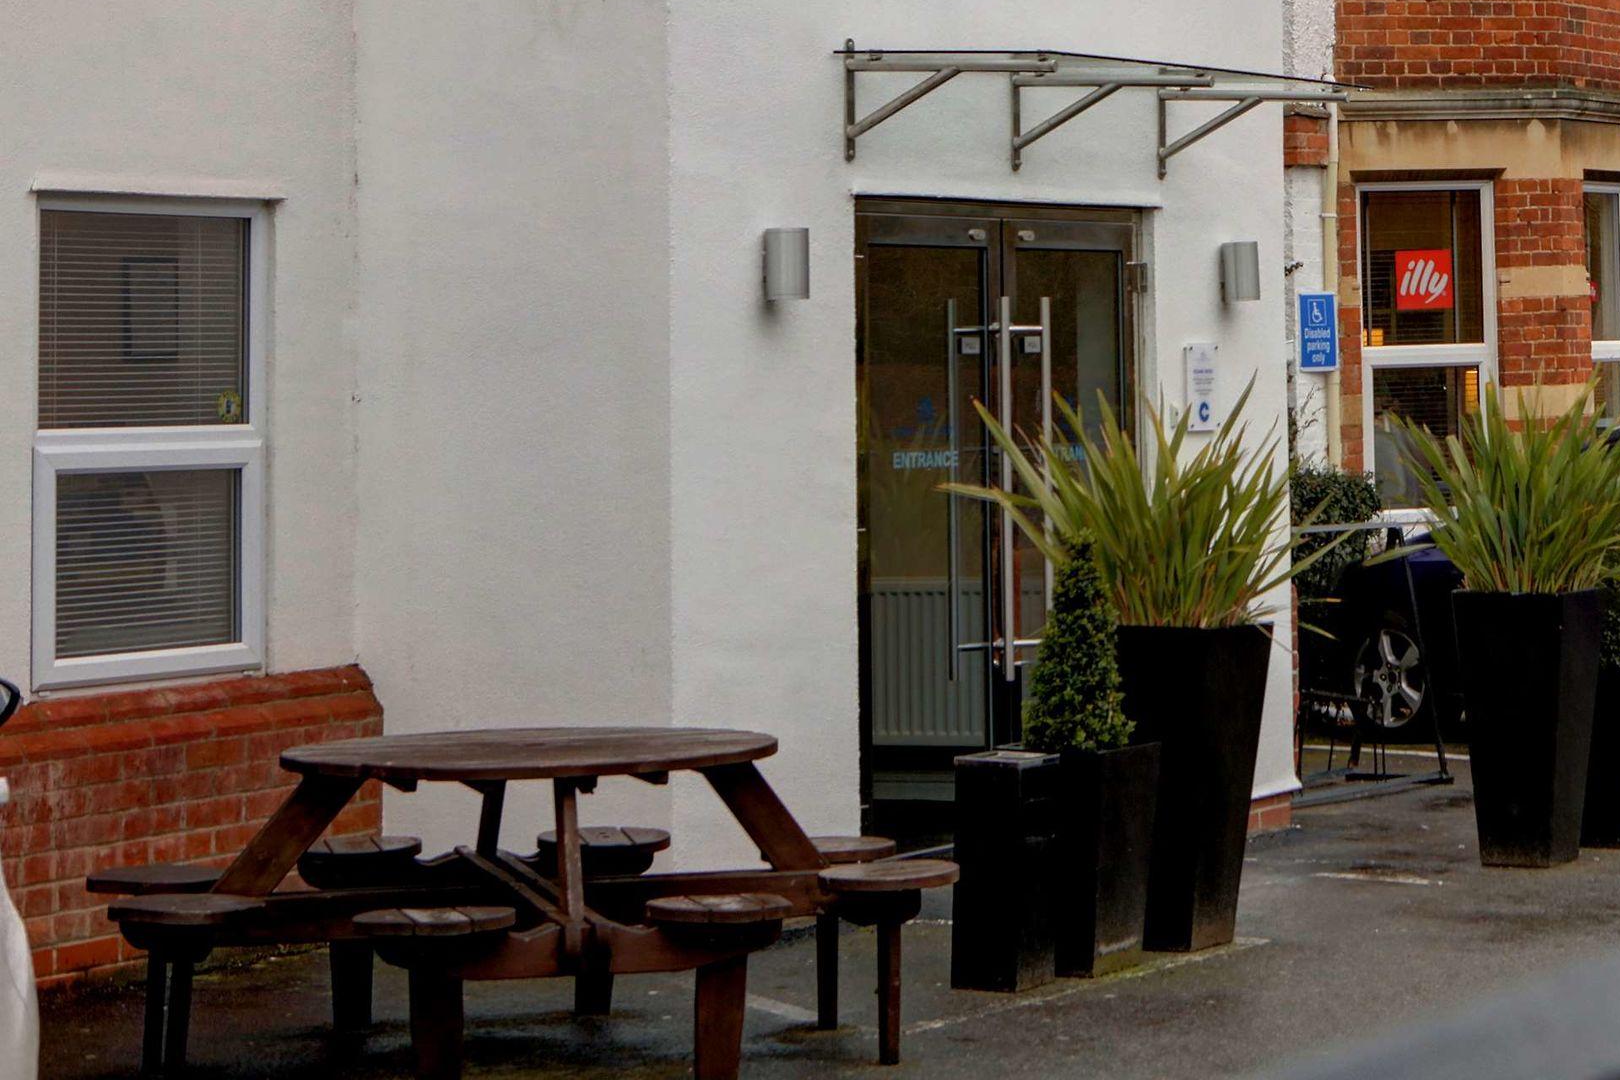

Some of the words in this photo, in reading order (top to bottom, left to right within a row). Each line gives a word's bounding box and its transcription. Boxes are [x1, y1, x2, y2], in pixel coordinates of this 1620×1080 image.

[1400, 259, 1449, 304] illy
[1304, 327, 1331, 339] Disabled
[1306, 339, 1331, 353] parking
[1312, 352, 1326, 365] only
[893, 450, 958, 469] ENTRANCE
